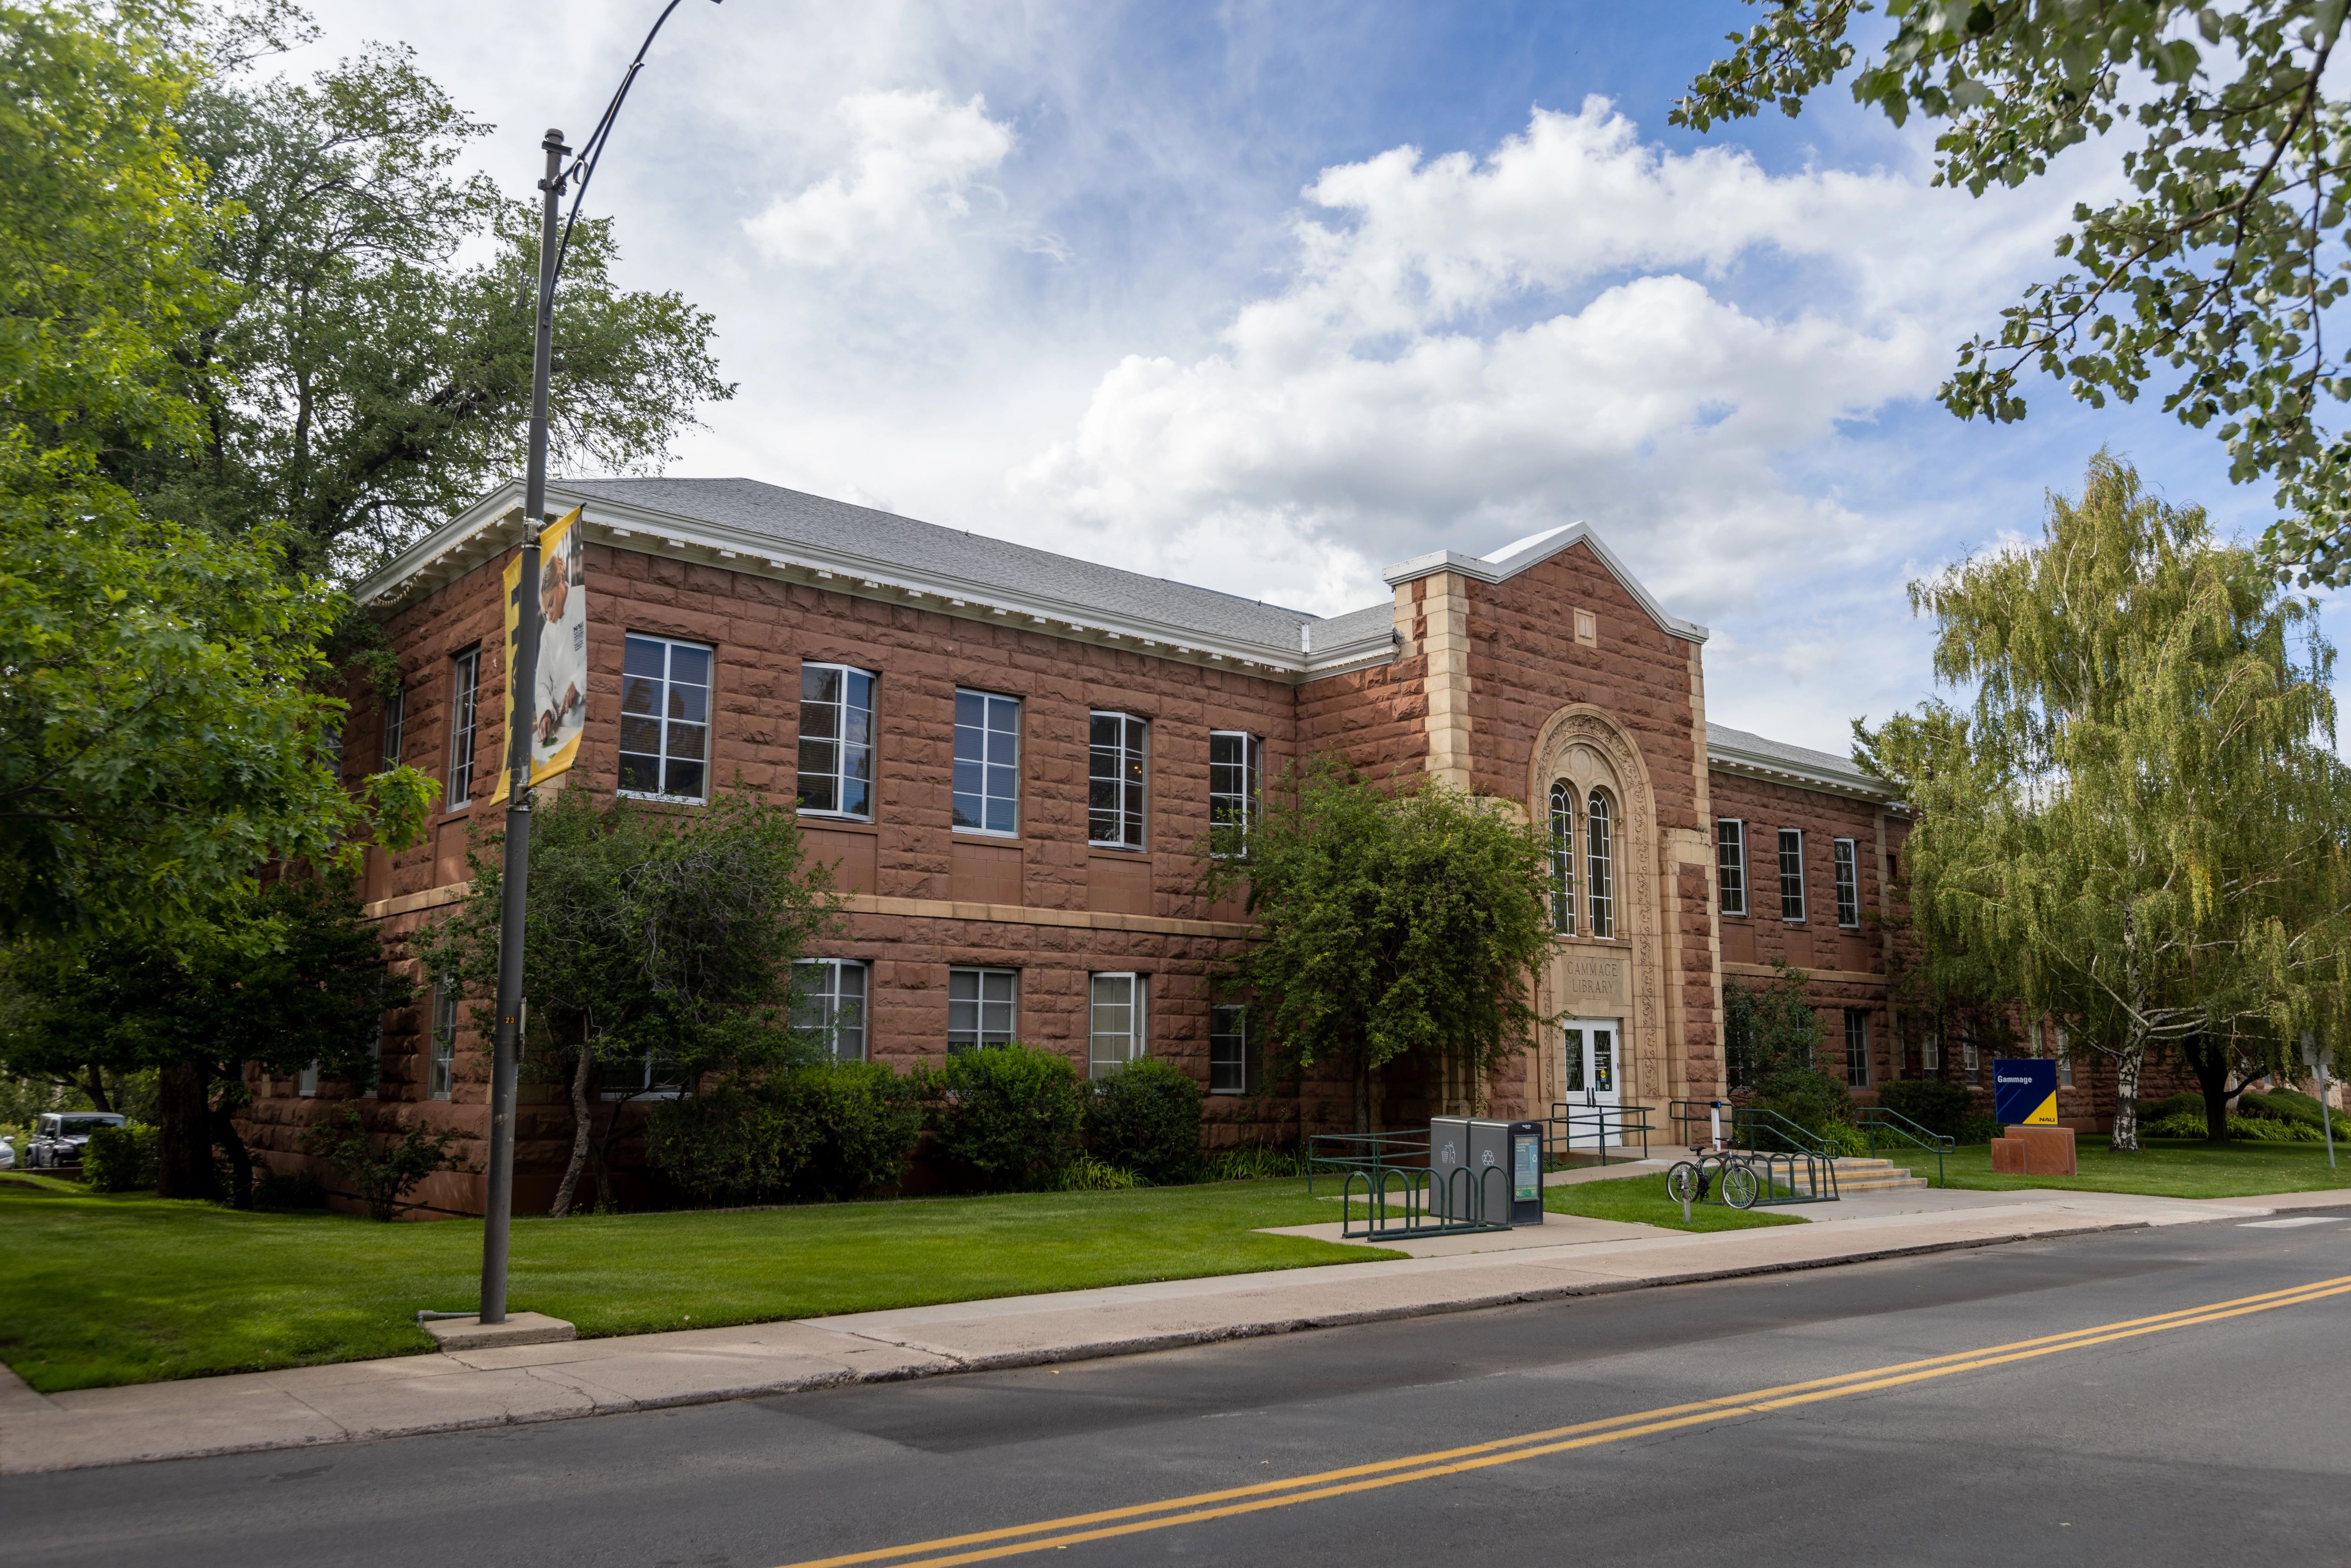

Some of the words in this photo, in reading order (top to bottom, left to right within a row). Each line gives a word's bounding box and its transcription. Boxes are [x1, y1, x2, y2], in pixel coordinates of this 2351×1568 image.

[574, 621, 584, 632] NAU
[1567, 961, 1618, 977] GAMMAGE
[1572, 979, 1614, 993] LIBRARY
[1997, 1075, 2032, 1084] Gammage
